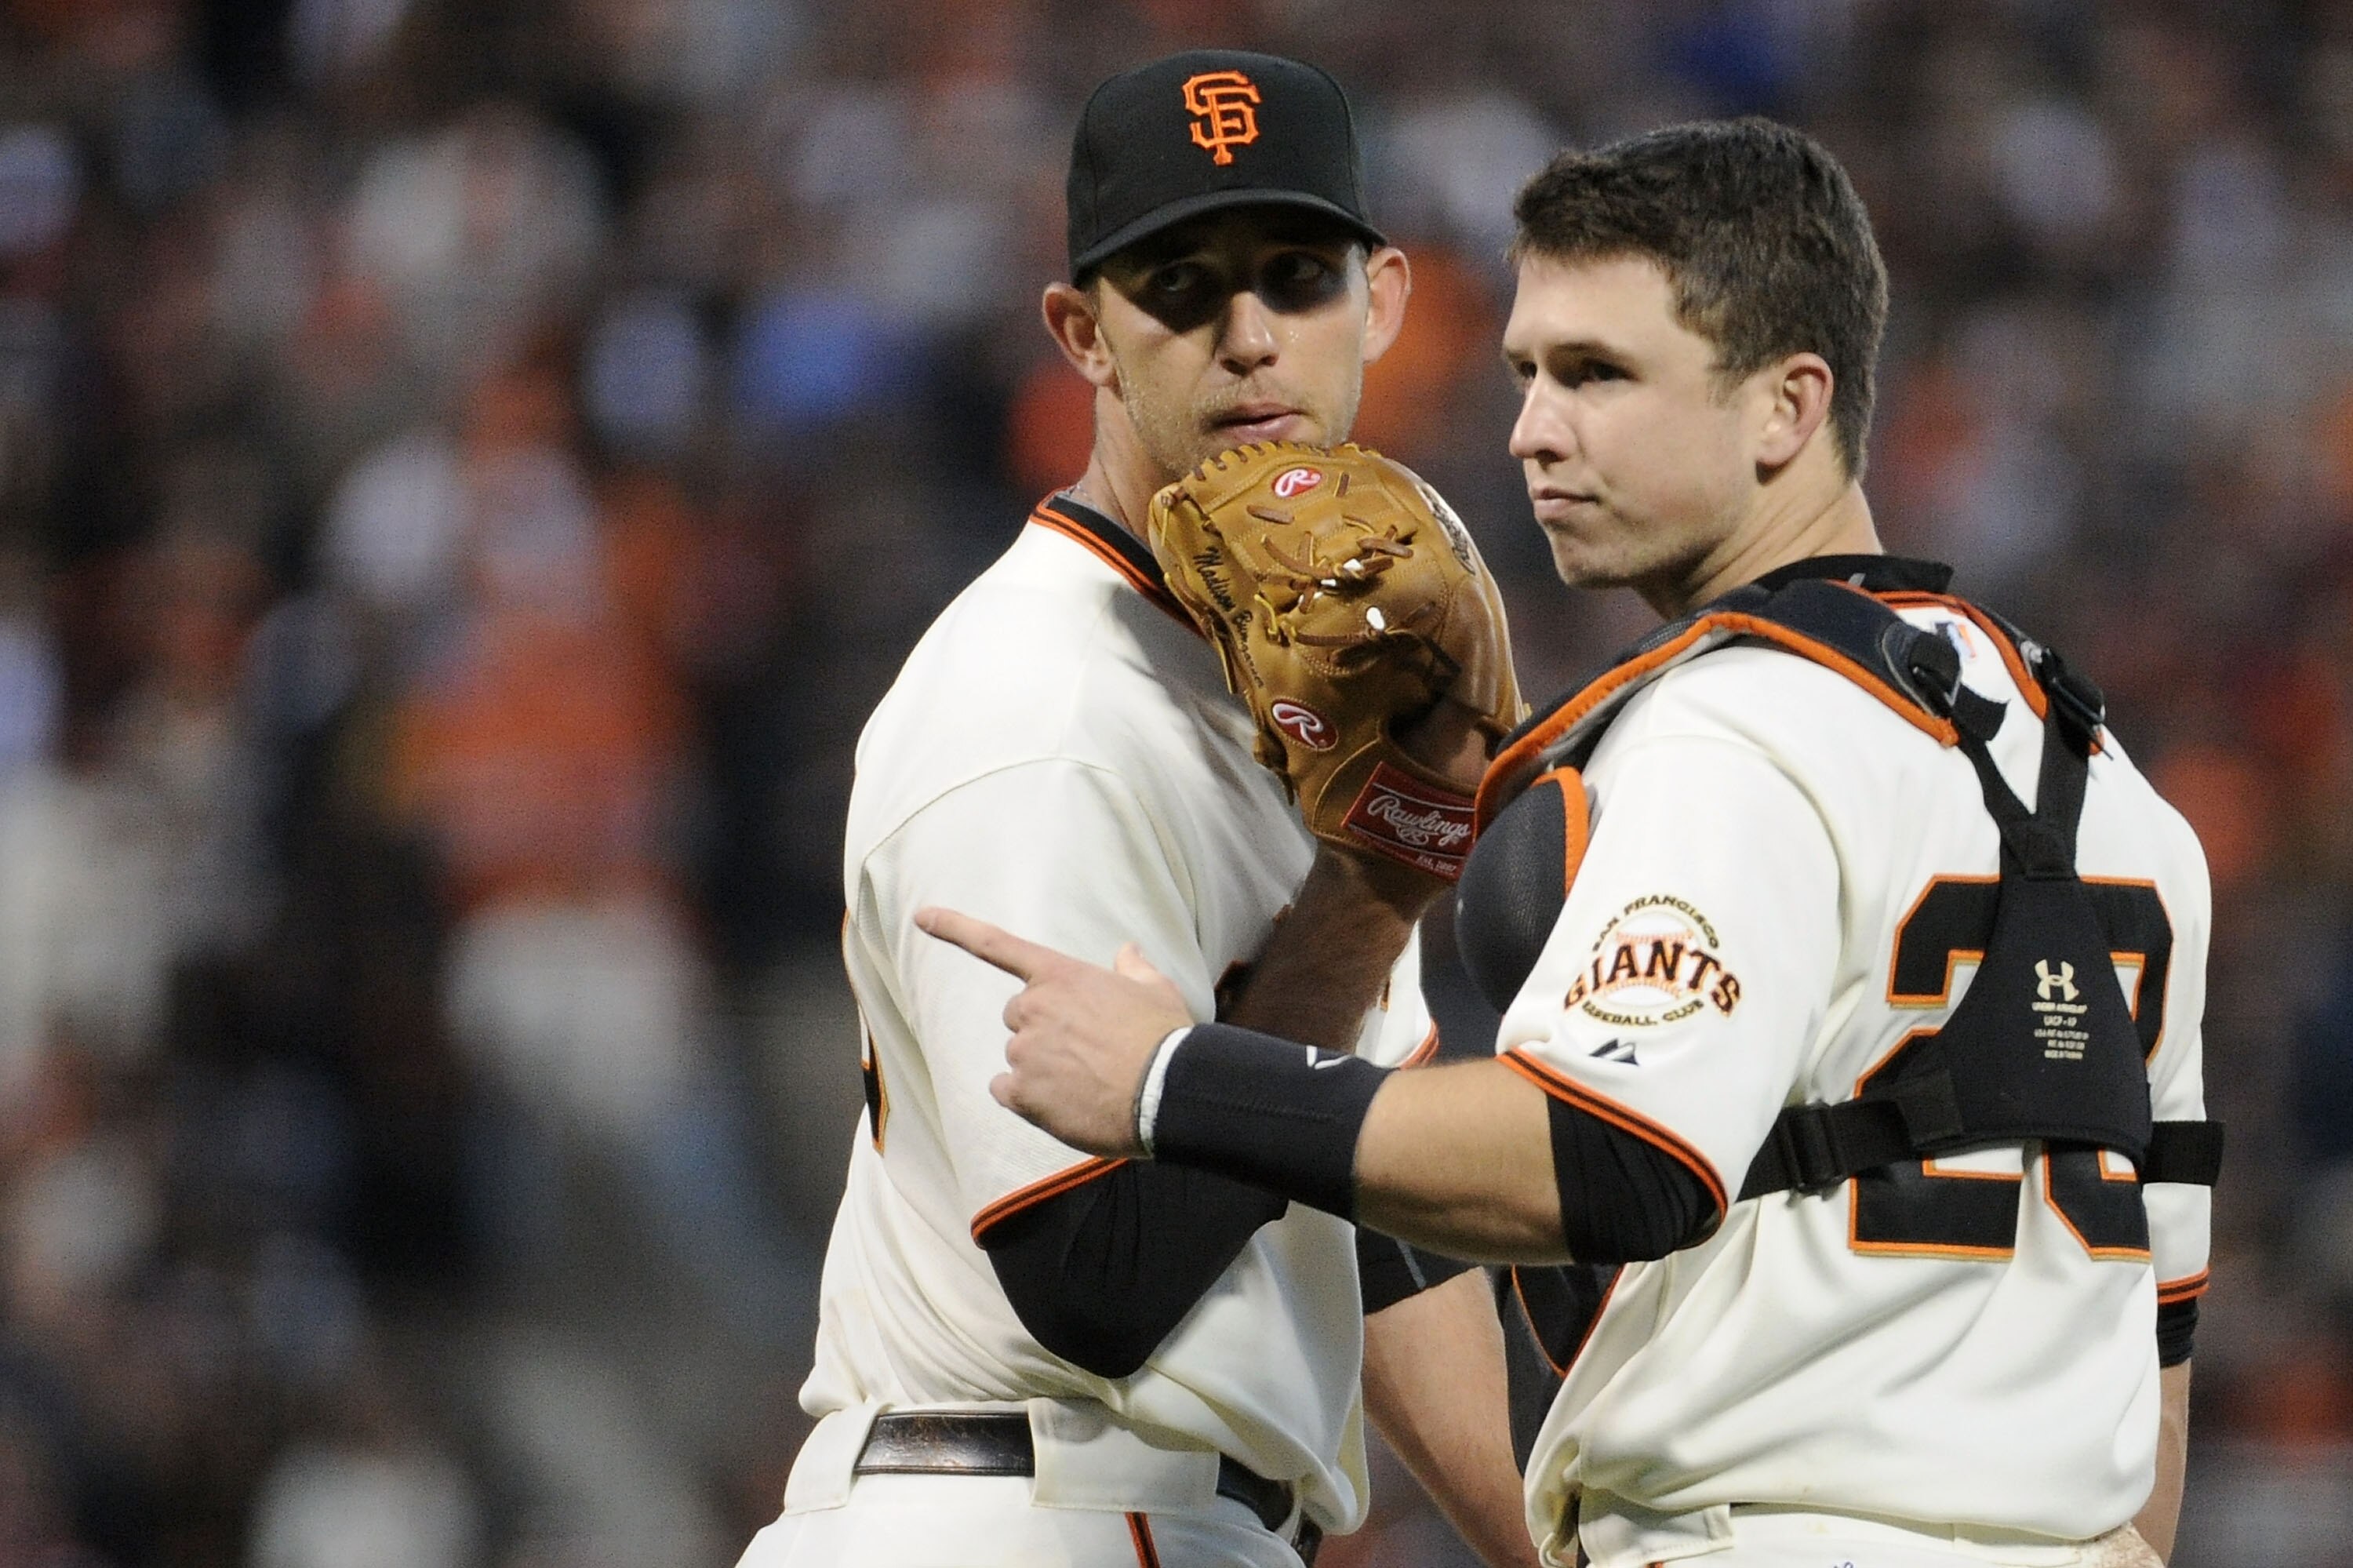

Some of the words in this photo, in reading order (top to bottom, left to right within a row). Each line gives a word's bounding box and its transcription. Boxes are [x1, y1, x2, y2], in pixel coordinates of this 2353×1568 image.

[1181, 70, 1261, 166] SF
[1366, 795, 1471, 846] Rawlings
[1593, 916, 1619, 951] SAN
[1624, 895, 1719, 949] FRANCISCO
[1564, 940, 1741, 1017] GIANTS
[1581, 1000, 1655, 1026] BASEBALL
[1662, 999, 1704, 1021] CLUB
